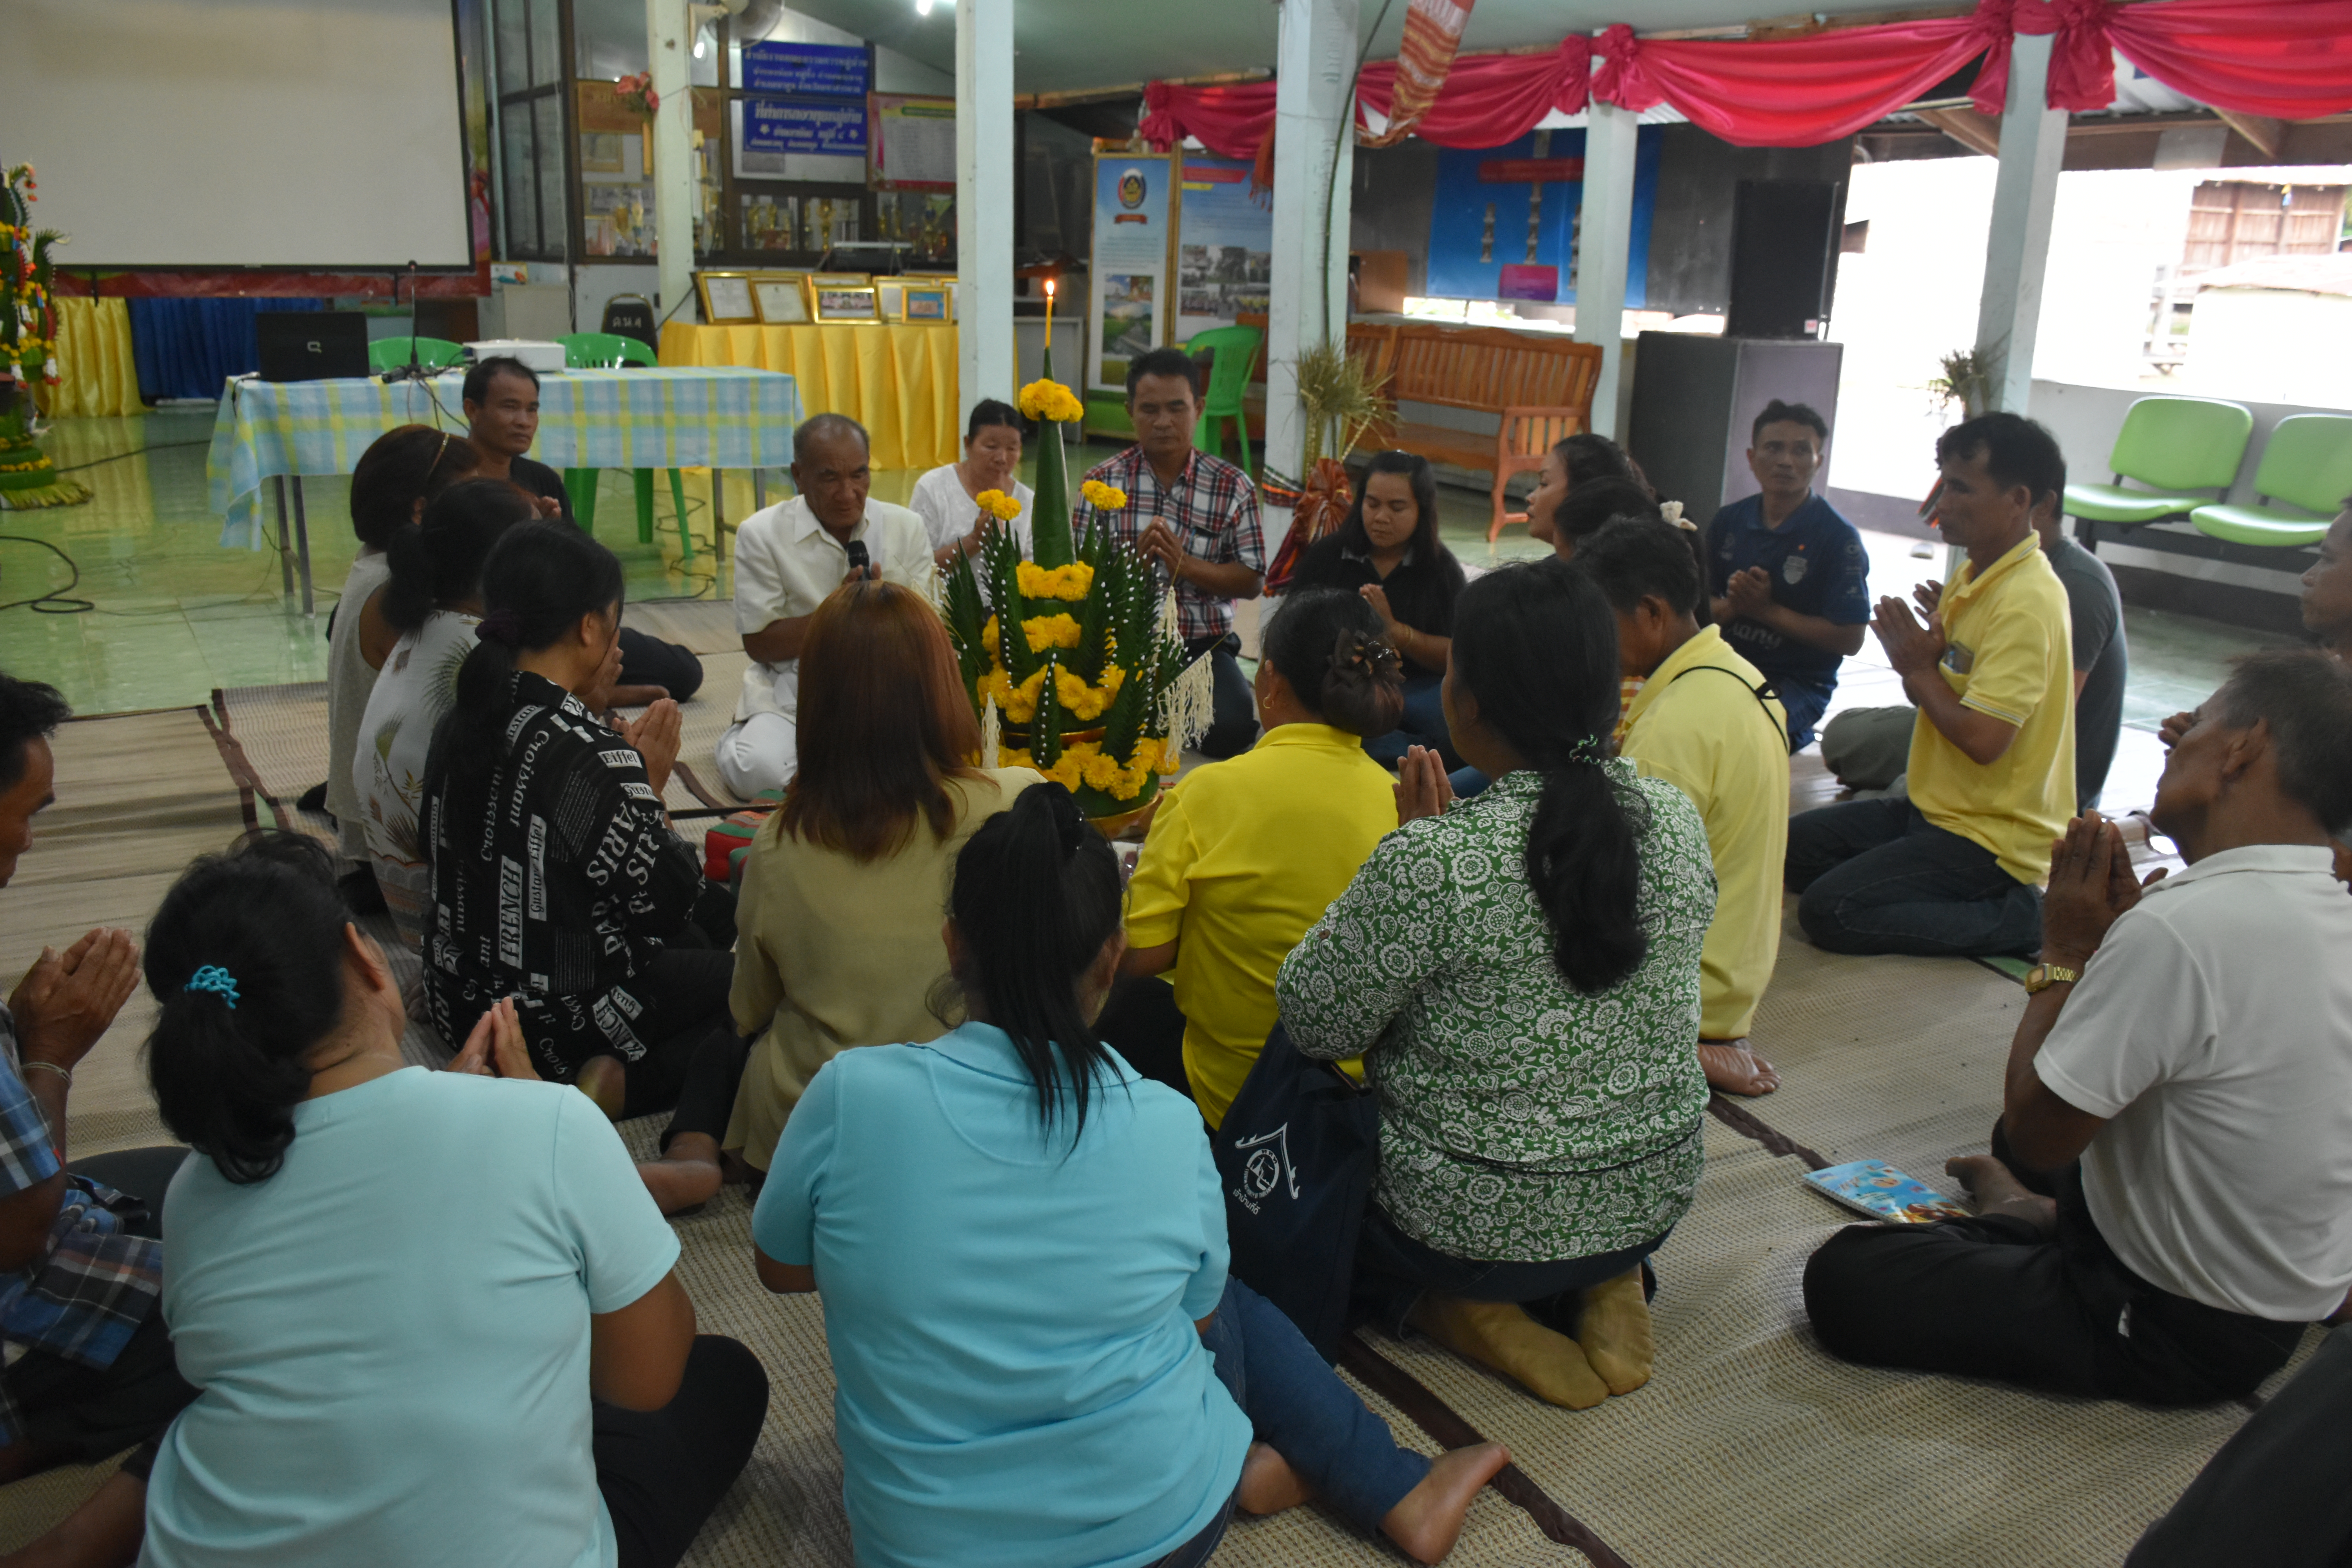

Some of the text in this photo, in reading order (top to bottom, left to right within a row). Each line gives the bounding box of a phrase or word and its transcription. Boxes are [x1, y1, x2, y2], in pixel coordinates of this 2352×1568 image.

[510, 730, 550, 827] Croissant
[603, 751, 638, 764] Eiffel
[501, 865, 521, 959] FRENCH
[1233, 1188, 1261, 1215] เจ้าบ้านที่ดี
